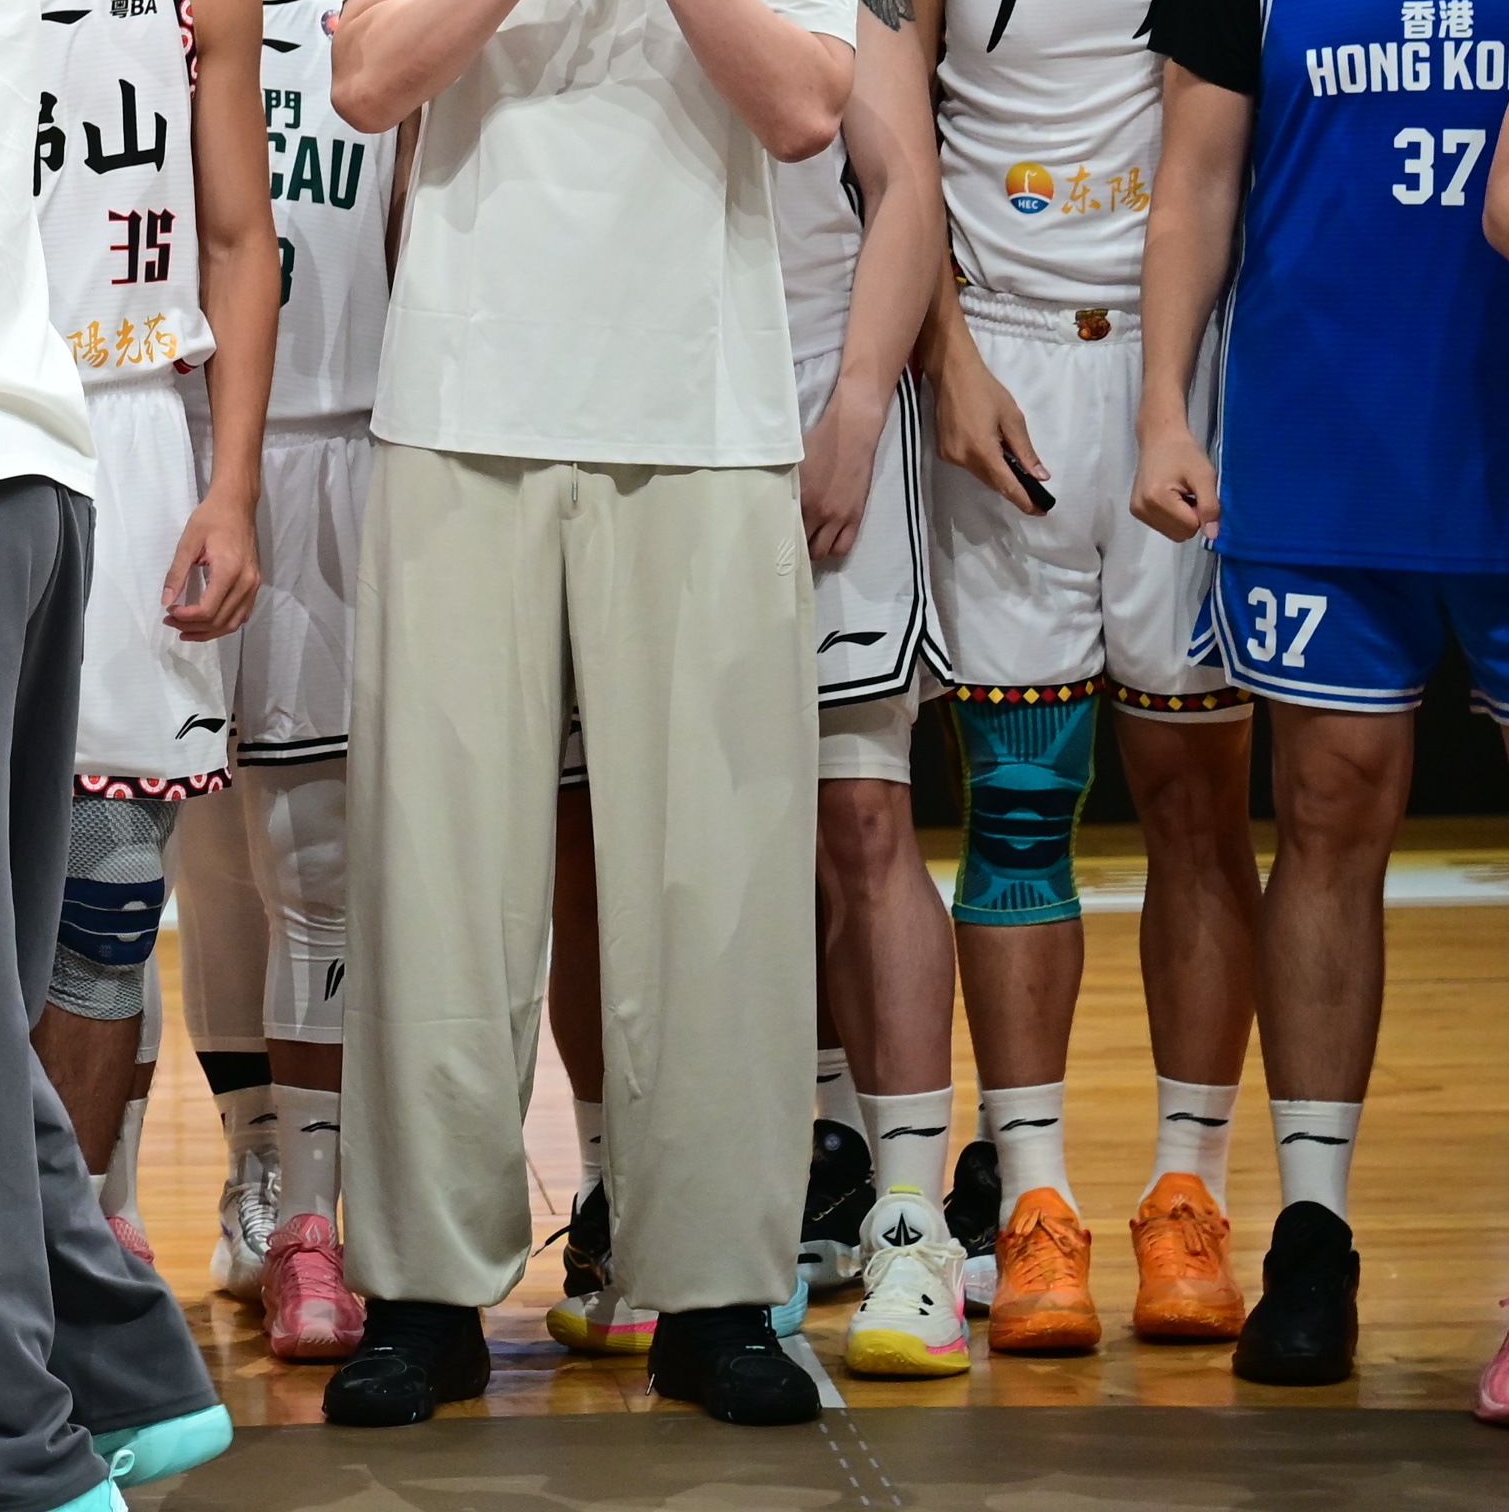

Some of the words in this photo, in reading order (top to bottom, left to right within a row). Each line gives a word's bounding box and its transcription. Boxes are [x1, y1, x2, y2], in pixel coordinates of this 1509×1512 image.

[1401, 0, 1474, 39] 香港
[1306, 41, 1431, 97] HONG
[1443, 40, 1509, 90] KO
[262, 88, 302, 129] 門
[268, 132, 366, 210] CAU
[1392, 127, 1486, 206] 37
[1018, 199, 1038, 210] HEC
[108, 208, 176, 285] 35
[1246, 586, 1328, 668] 37
